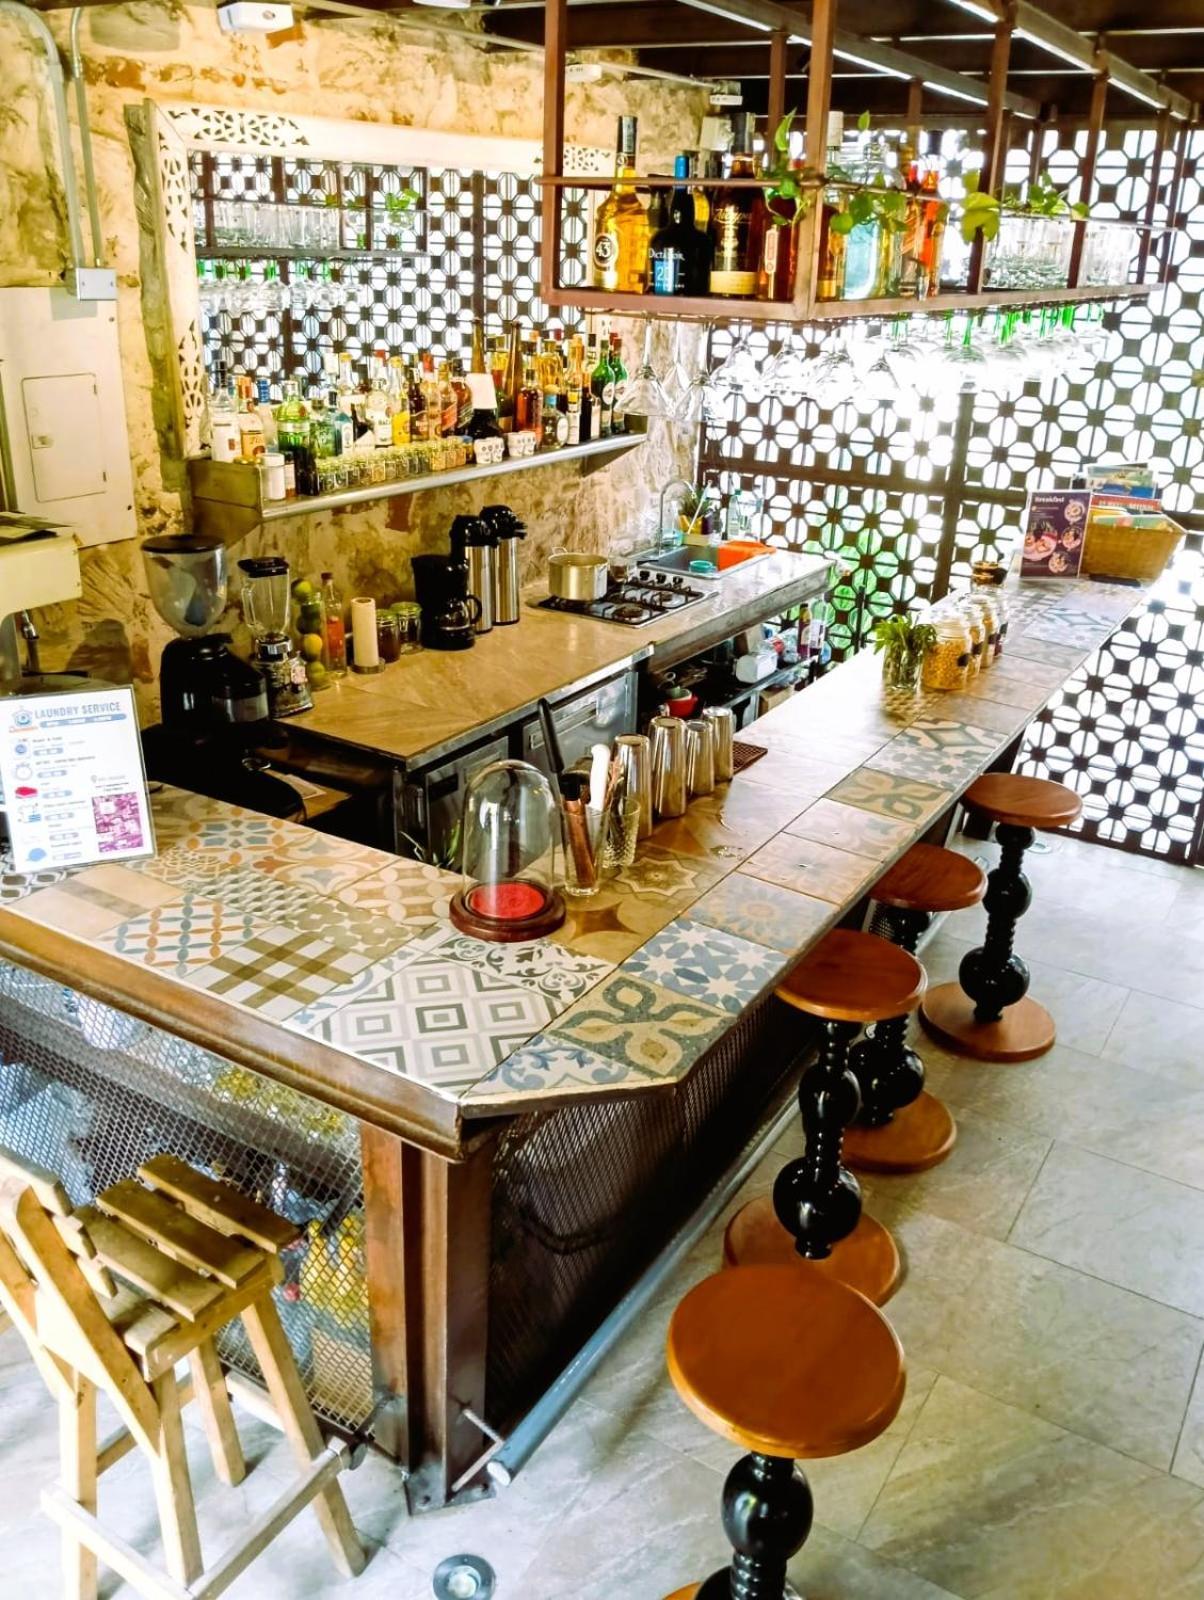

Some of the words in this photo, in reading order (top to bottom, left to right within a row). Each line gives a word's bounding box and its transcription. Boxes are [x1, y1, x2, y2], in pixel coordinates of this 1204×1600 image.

[595, 240, 611, 258] 43
[1034, 494, 1065, 503] Breakfast
[34, 706, 79, 719] LAUNDRY
[81, 701, 121, 714] SERVICE
